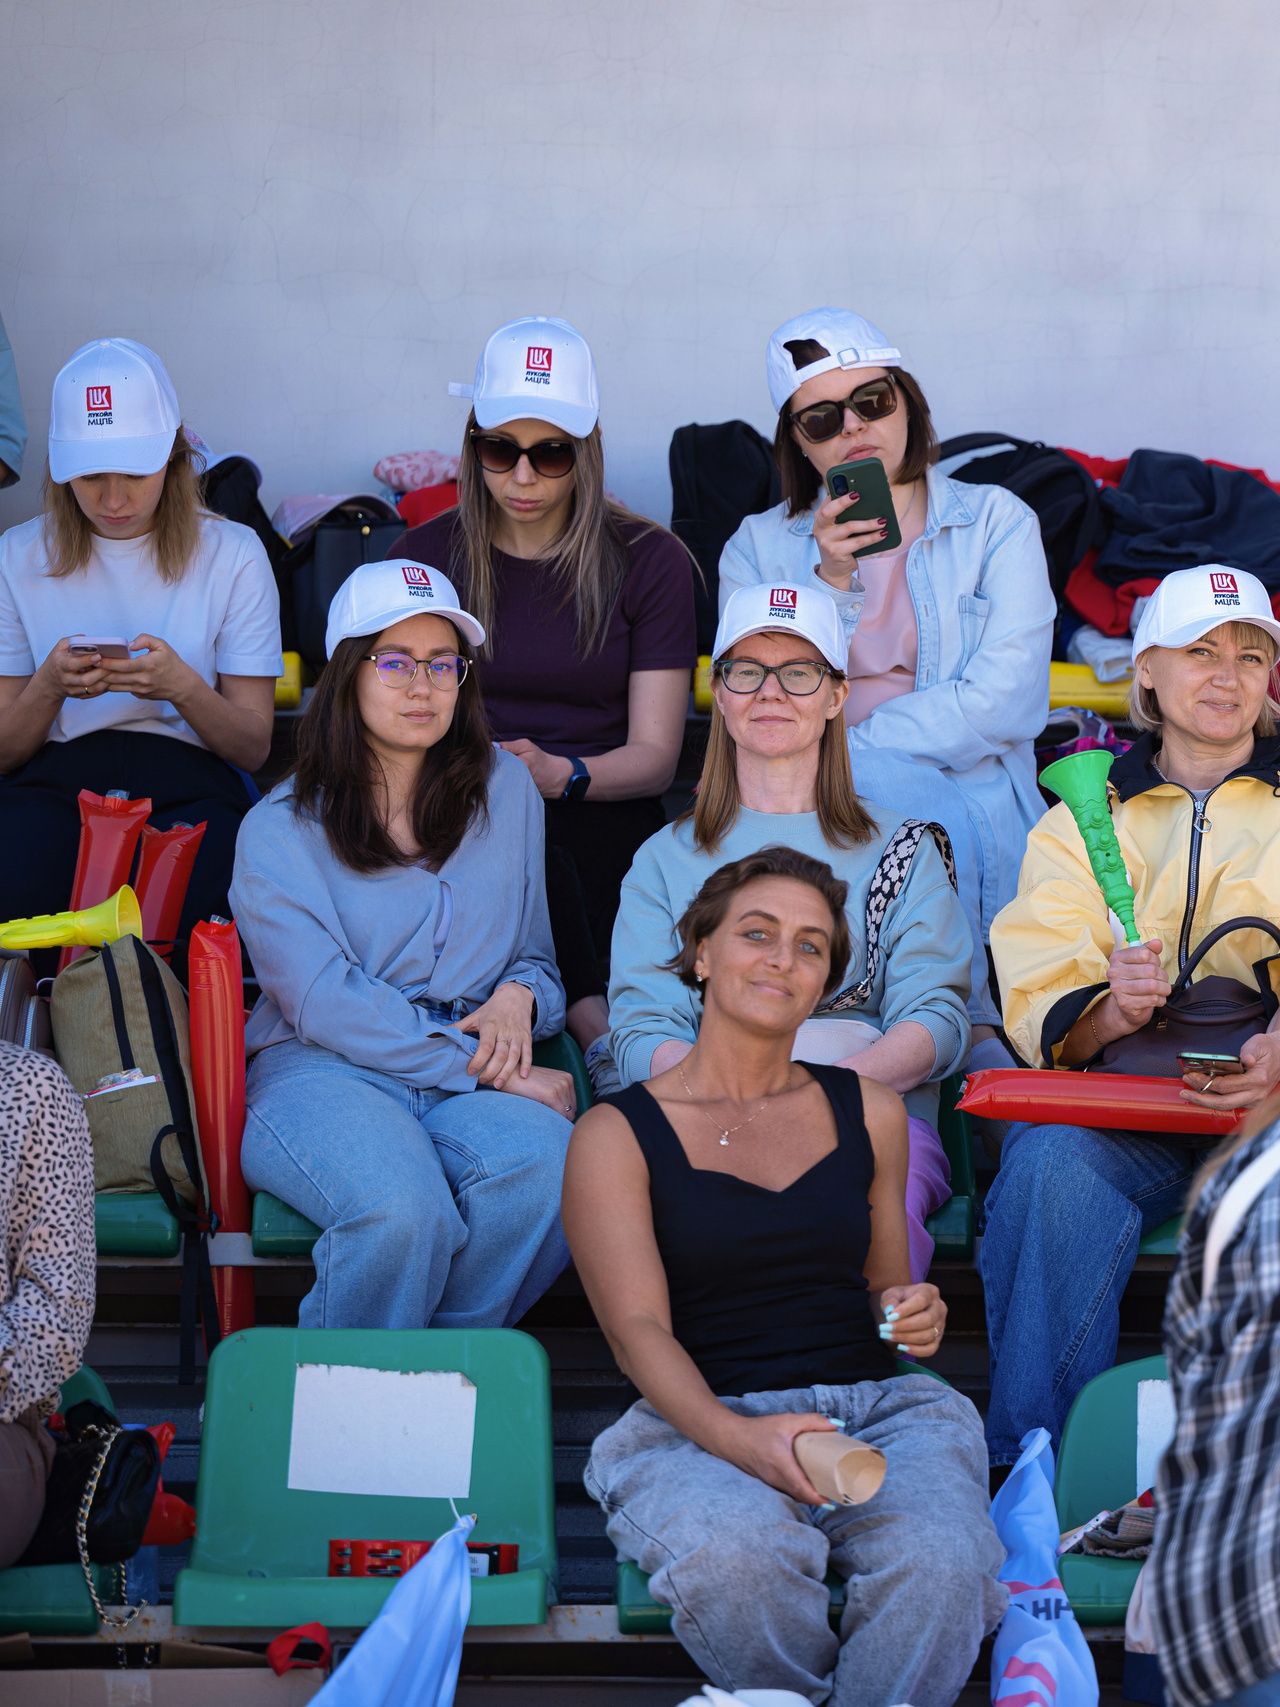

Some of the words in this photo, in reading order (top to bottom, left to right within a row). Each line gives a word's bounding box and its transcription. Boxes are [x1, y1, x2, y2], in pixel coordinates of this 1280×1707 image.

[529, 348, 550, 369] LUK
[88, 387, 111, 409] LUK
[87, 417, 113, 426] МЦПБ
[404, 568, 429, 584] LUK
[1211, 574, 1237, 591] LUK
[772, 590, 795, 606] LUK
